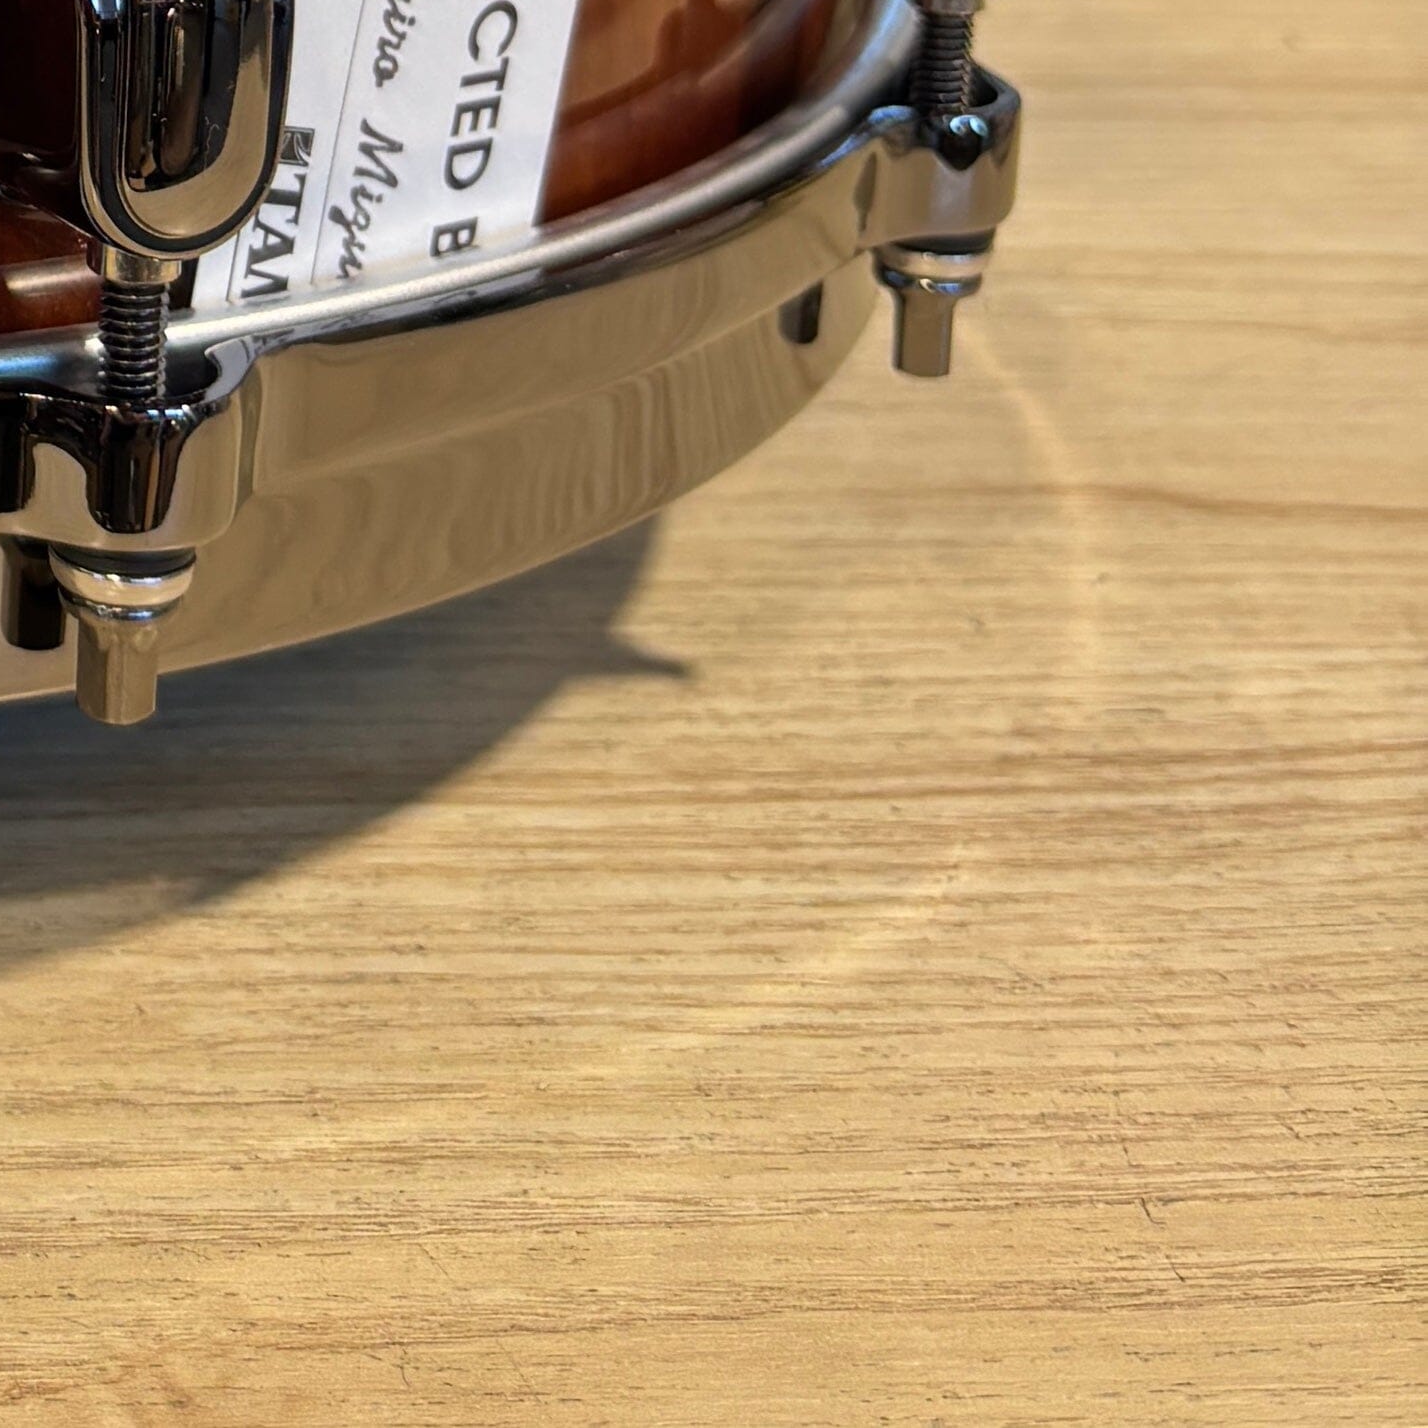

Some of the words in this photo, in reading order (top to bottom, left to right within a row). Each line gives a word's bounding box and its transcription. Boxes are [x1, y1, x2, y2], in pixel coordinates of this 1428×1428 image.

[241, 172, 307, 299] TAM
[327, 117, 404, 280] Mizu
[429, 216, 480, 258] B
